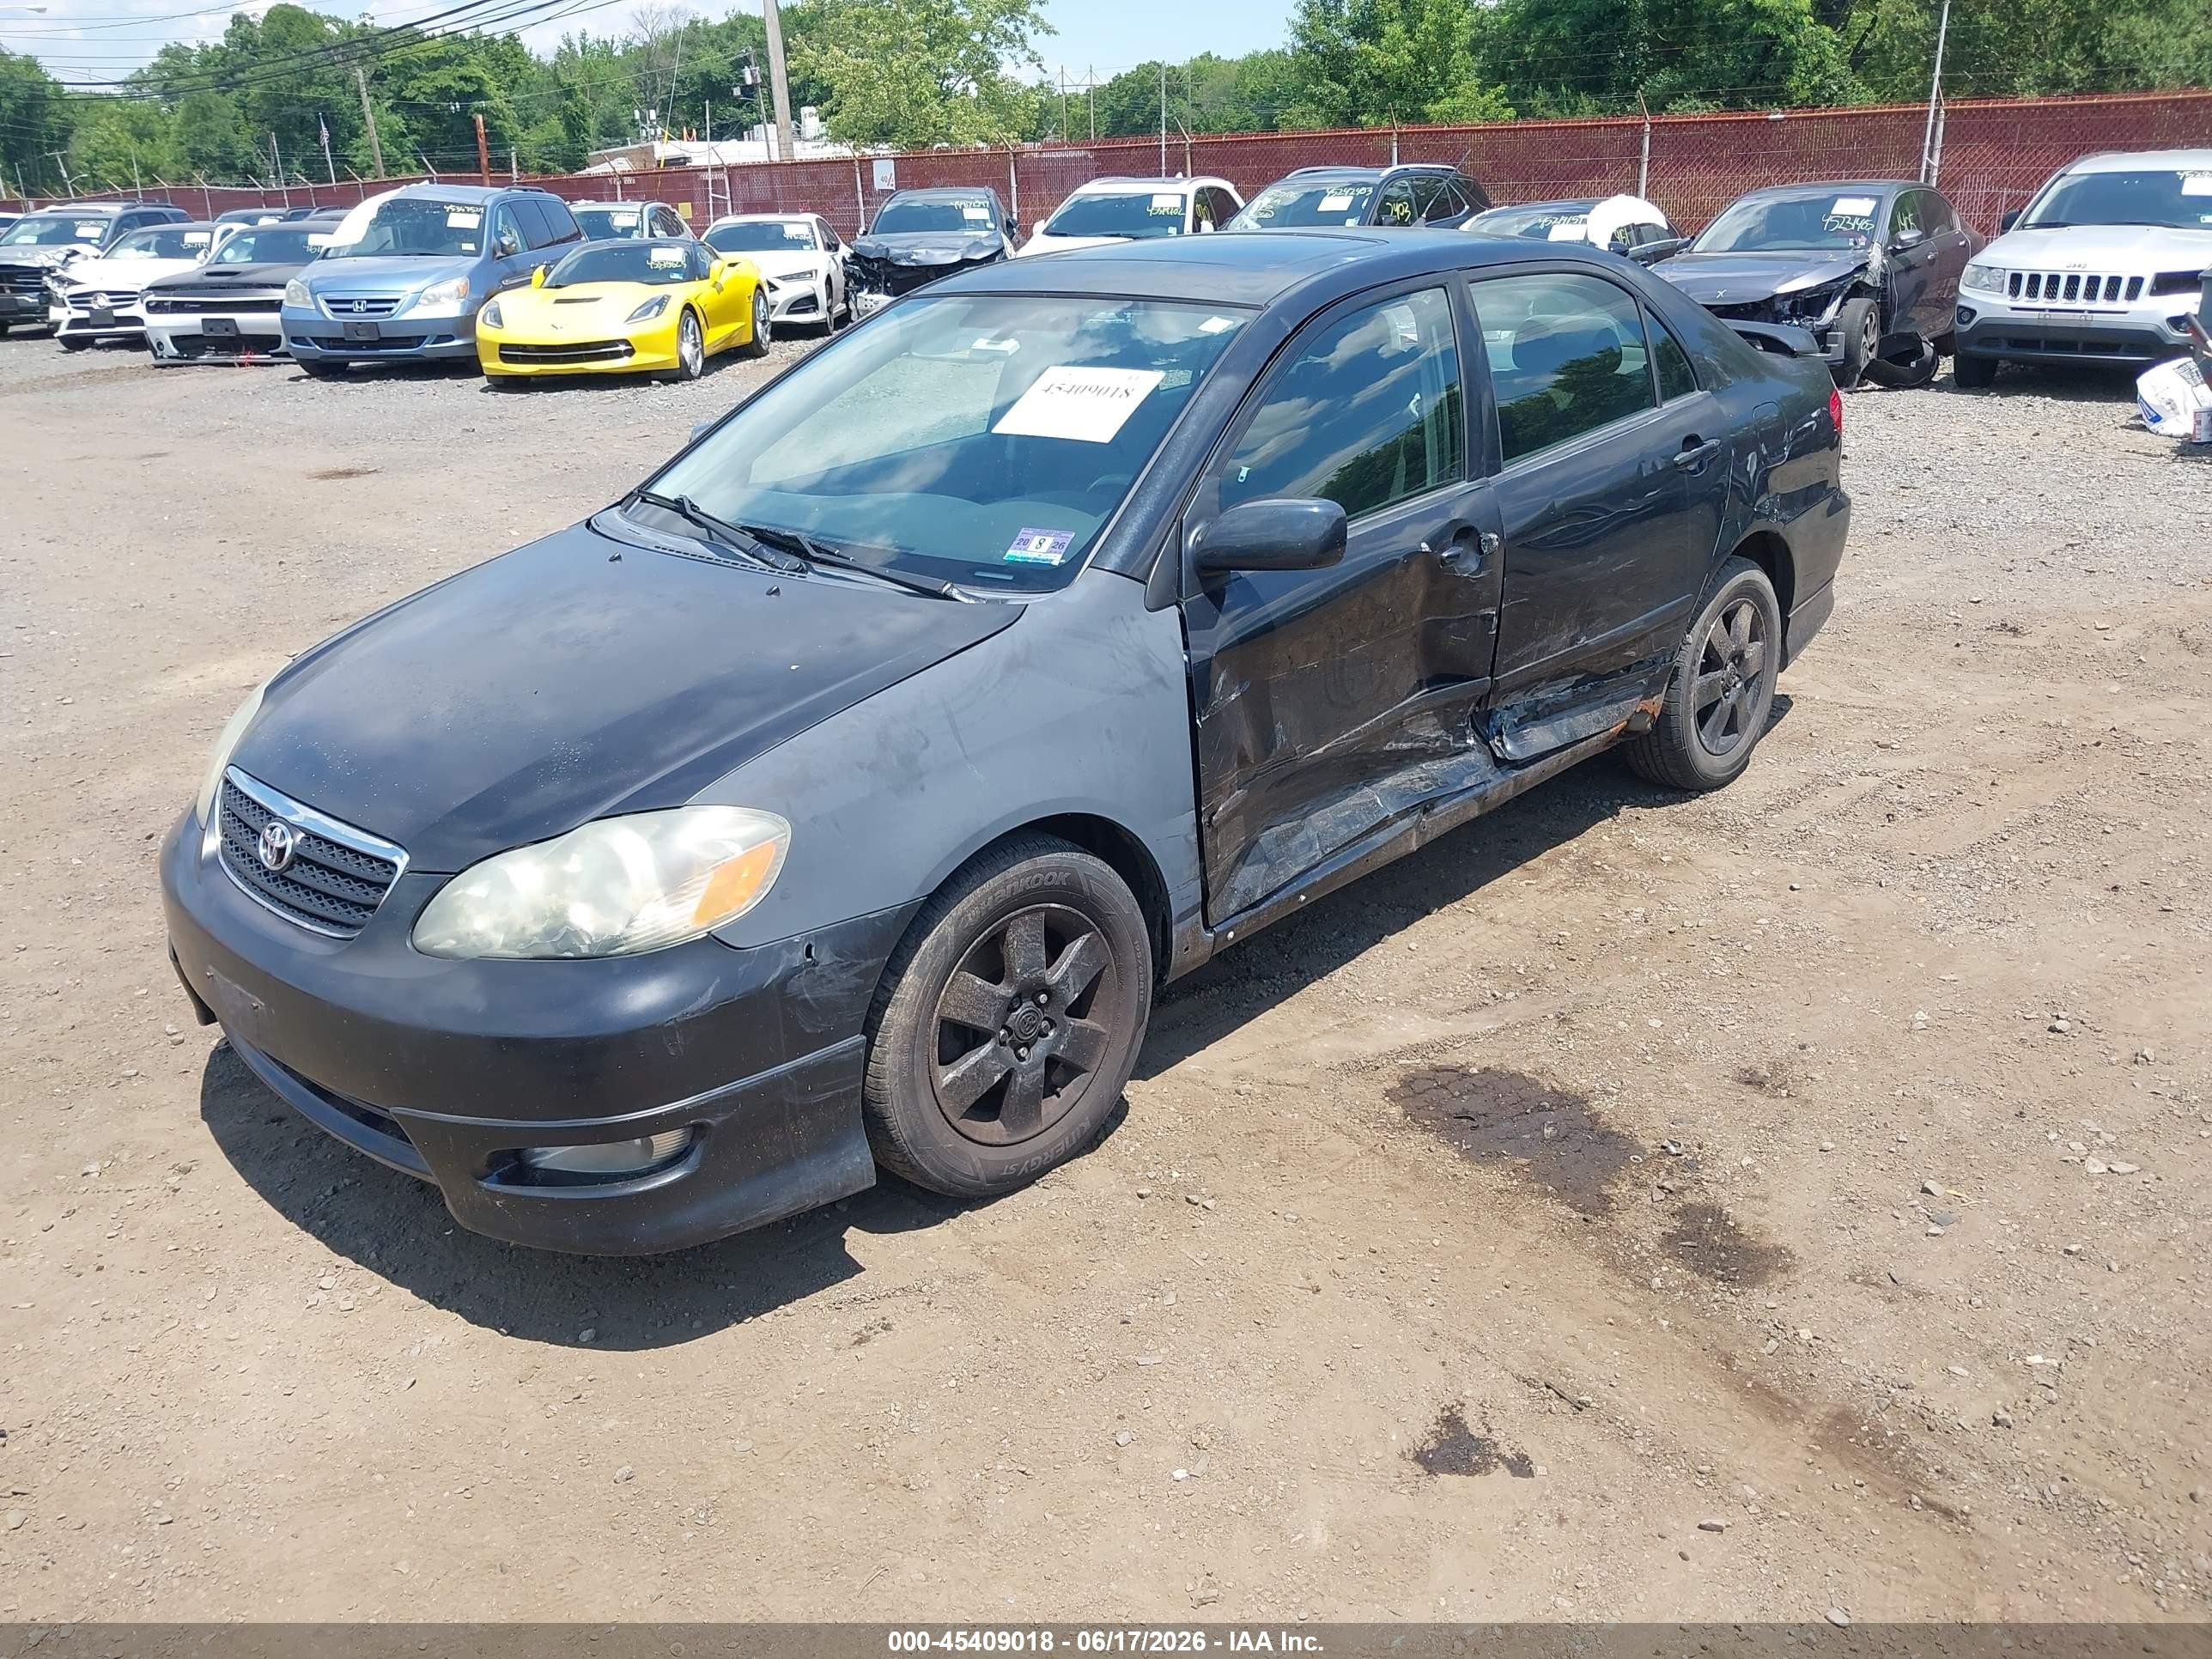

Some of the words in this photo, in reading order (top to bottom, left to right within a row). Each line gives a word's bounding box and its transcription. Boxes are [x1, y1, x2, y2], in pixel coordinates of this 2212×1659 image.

[2066, 261, 2087, 270] Jeep
[1040, 383, 1136, 399] 45409018
[1016, 537, 1030, 546] 20
[1036, 538, 1046, 550] 8
[1051, 541, 1066, 550] 26
